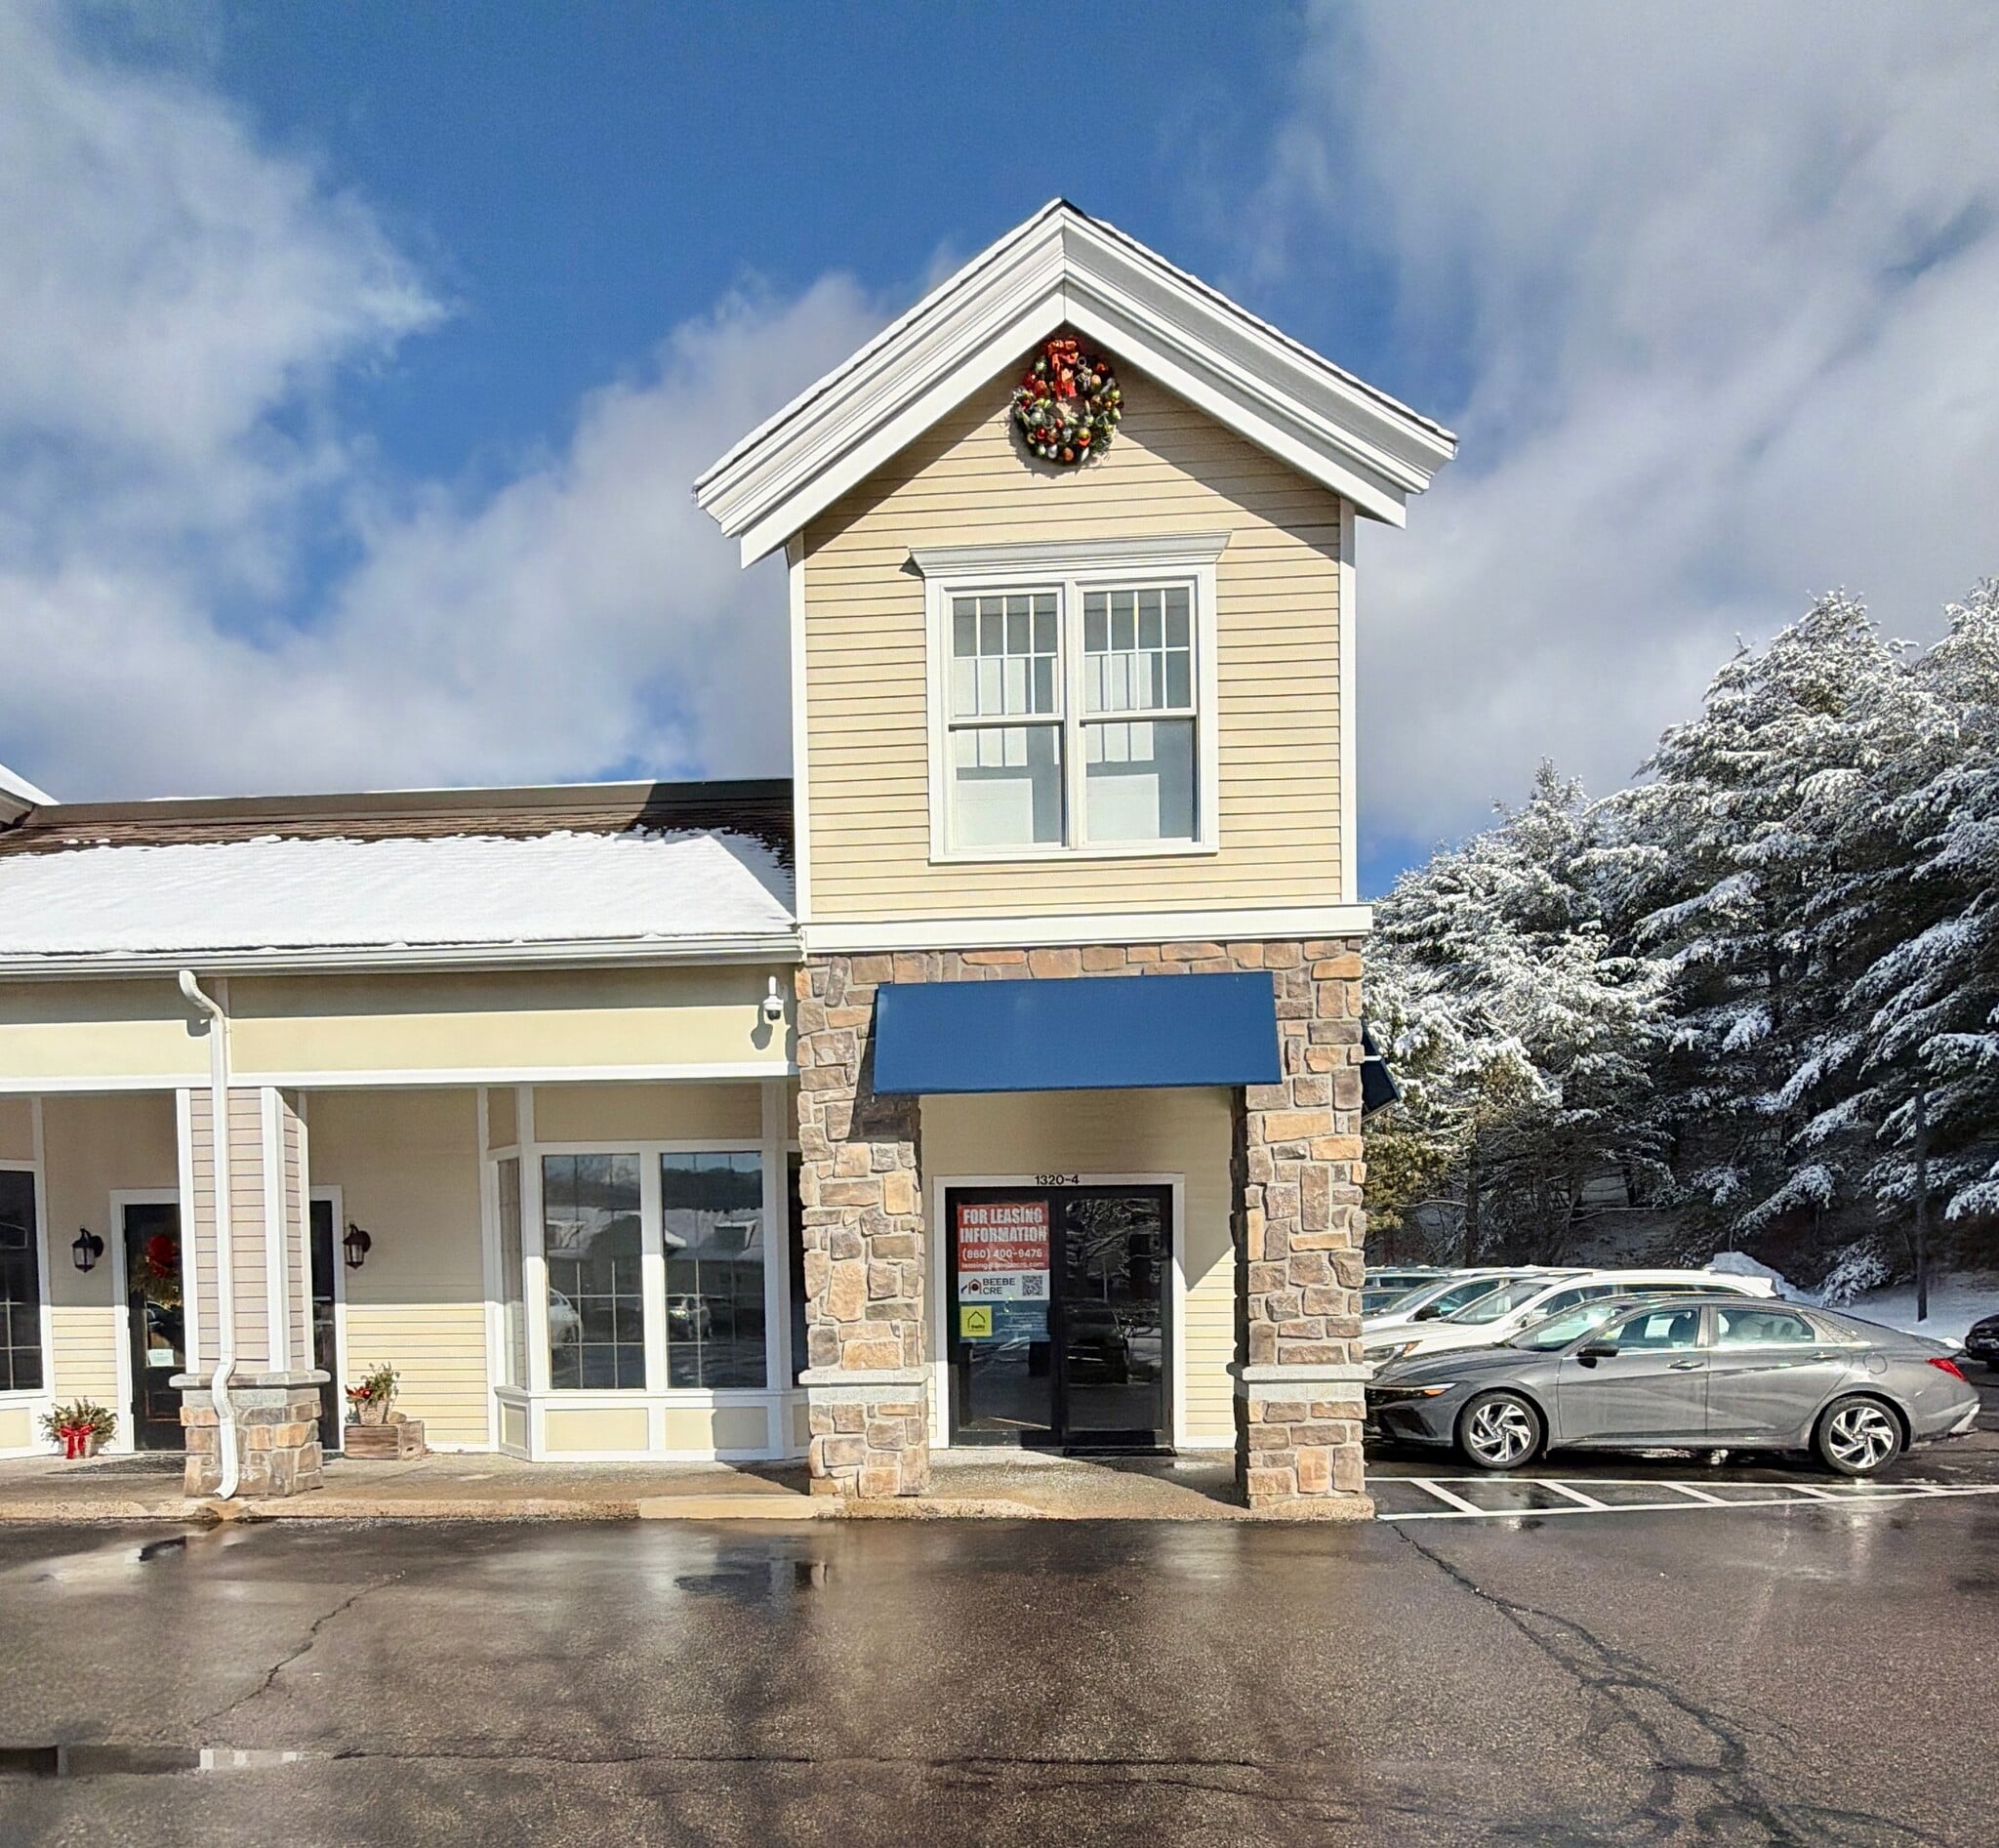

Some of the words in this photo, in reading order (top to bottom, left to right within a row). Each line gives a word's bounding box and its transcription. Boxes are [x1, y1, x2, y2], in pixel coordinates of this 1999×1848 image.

[1035, 1174, 1080, 1185] 1320-4
[963, 1209, 988, 1224] FOR
[991, 1207, 1042, 1223] LEASING
[960, 1226, 1046, 1243] INFORMATION
